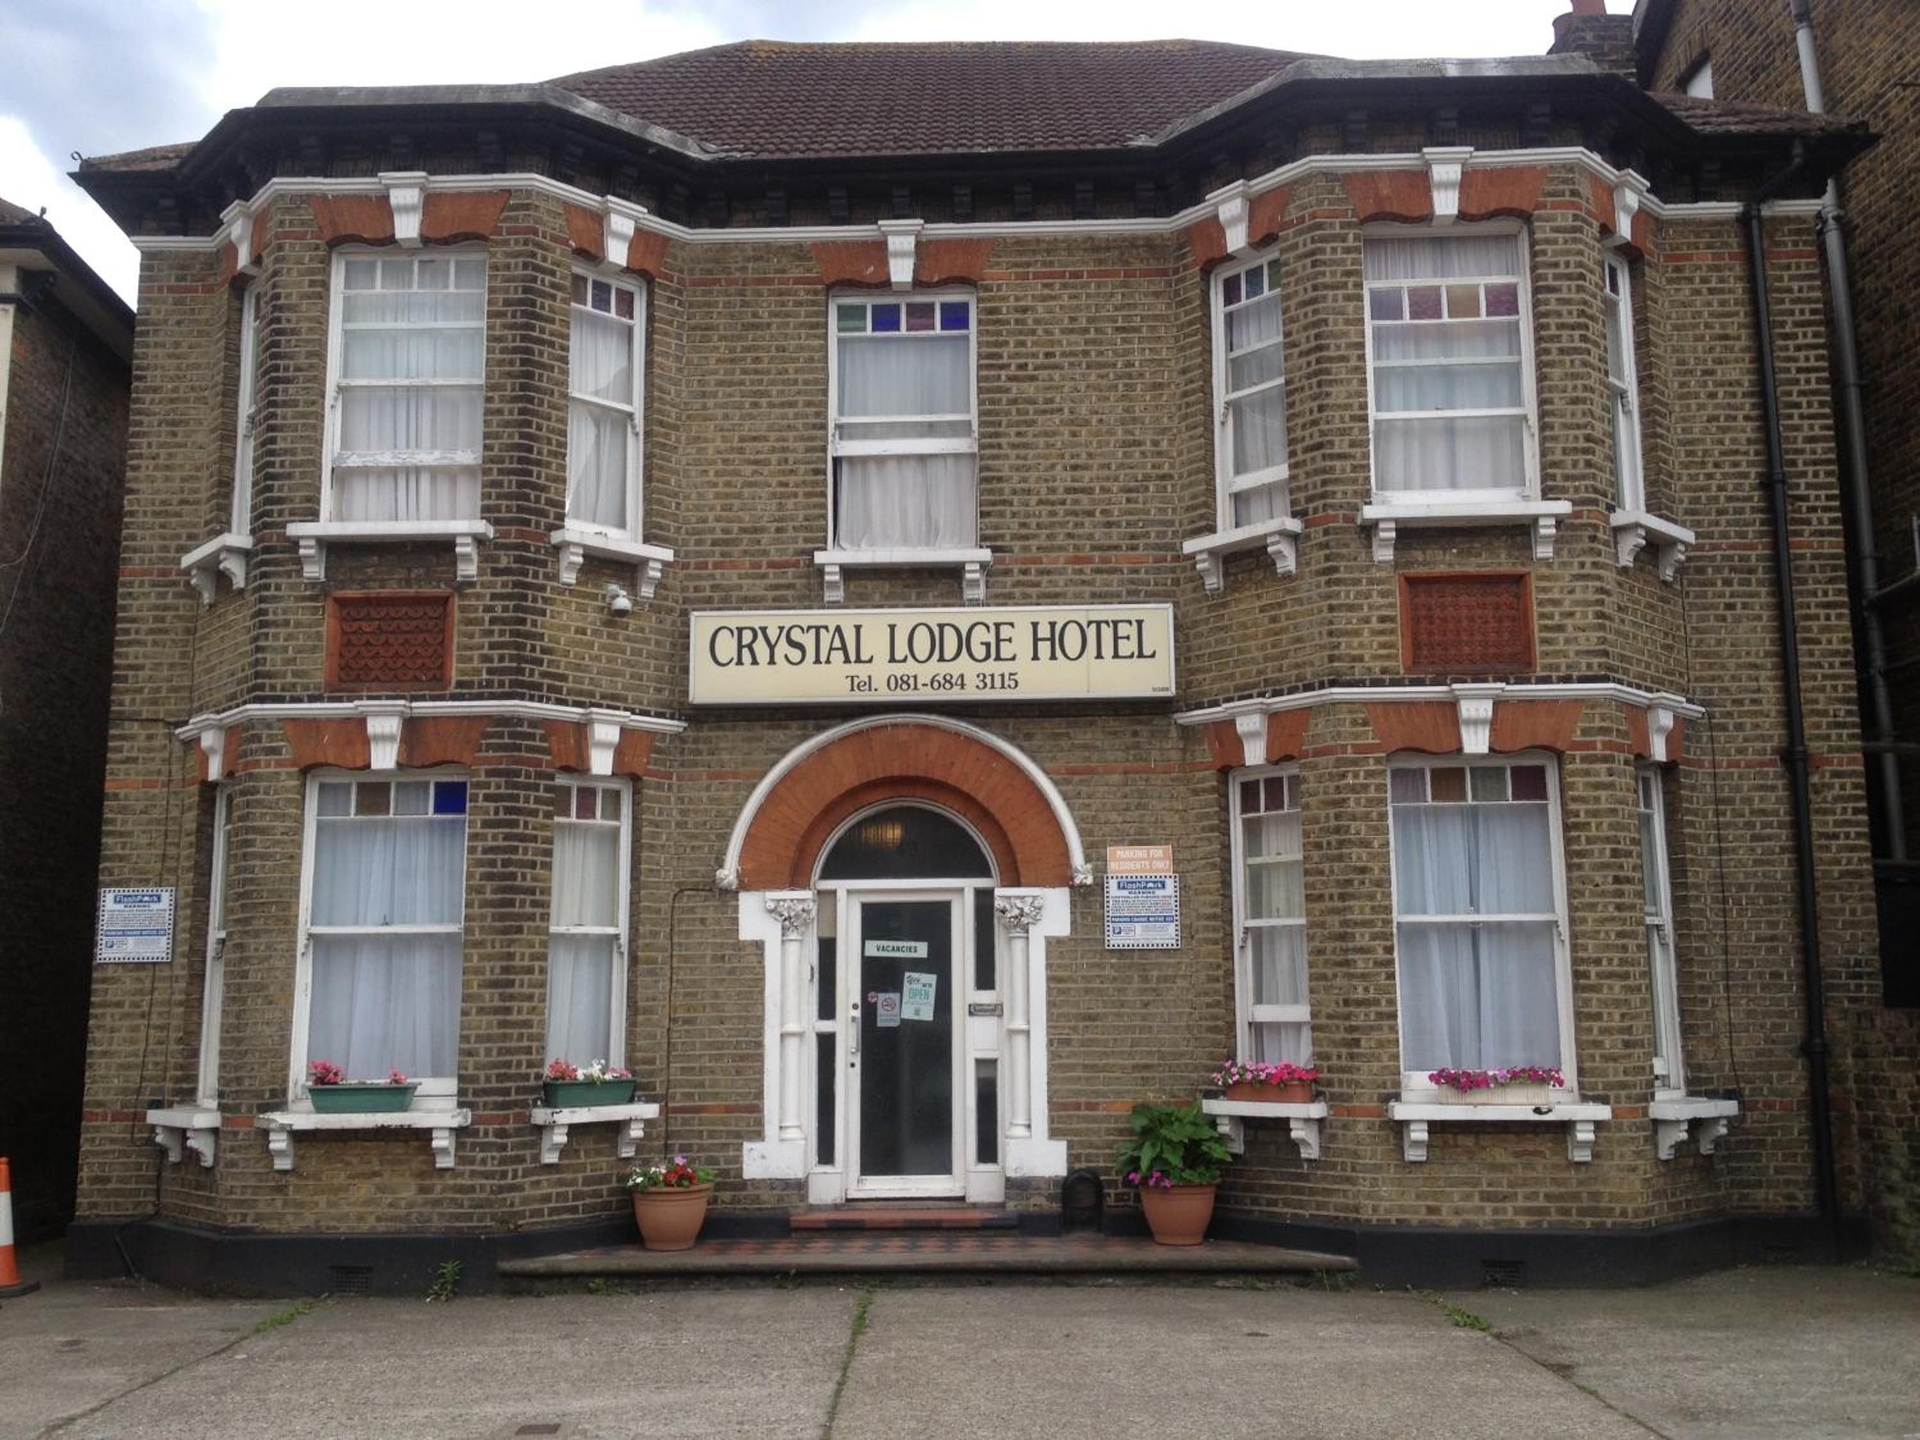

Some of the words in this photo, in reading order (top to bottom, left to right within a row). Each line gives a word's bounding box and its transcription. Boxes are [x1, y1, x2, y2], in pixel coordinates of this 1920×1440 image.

[709, 624, 874, 668] CRYSTAL
[887, 621, 1017, 664] LODGE
[1031, 619, 1157, 662] HOTEL
[846, 675, 879, 692] Tel.
[886, 673, 967, 691] 081-684
[975, 672, 1019, 690] 3115
[1116, 849, 1147, 859] PARKING
[1150, 849, 1163, 858] FOR
[876, 945, 918, 953] VACANCIES
[909, 987, 930, 1001] OPEN
